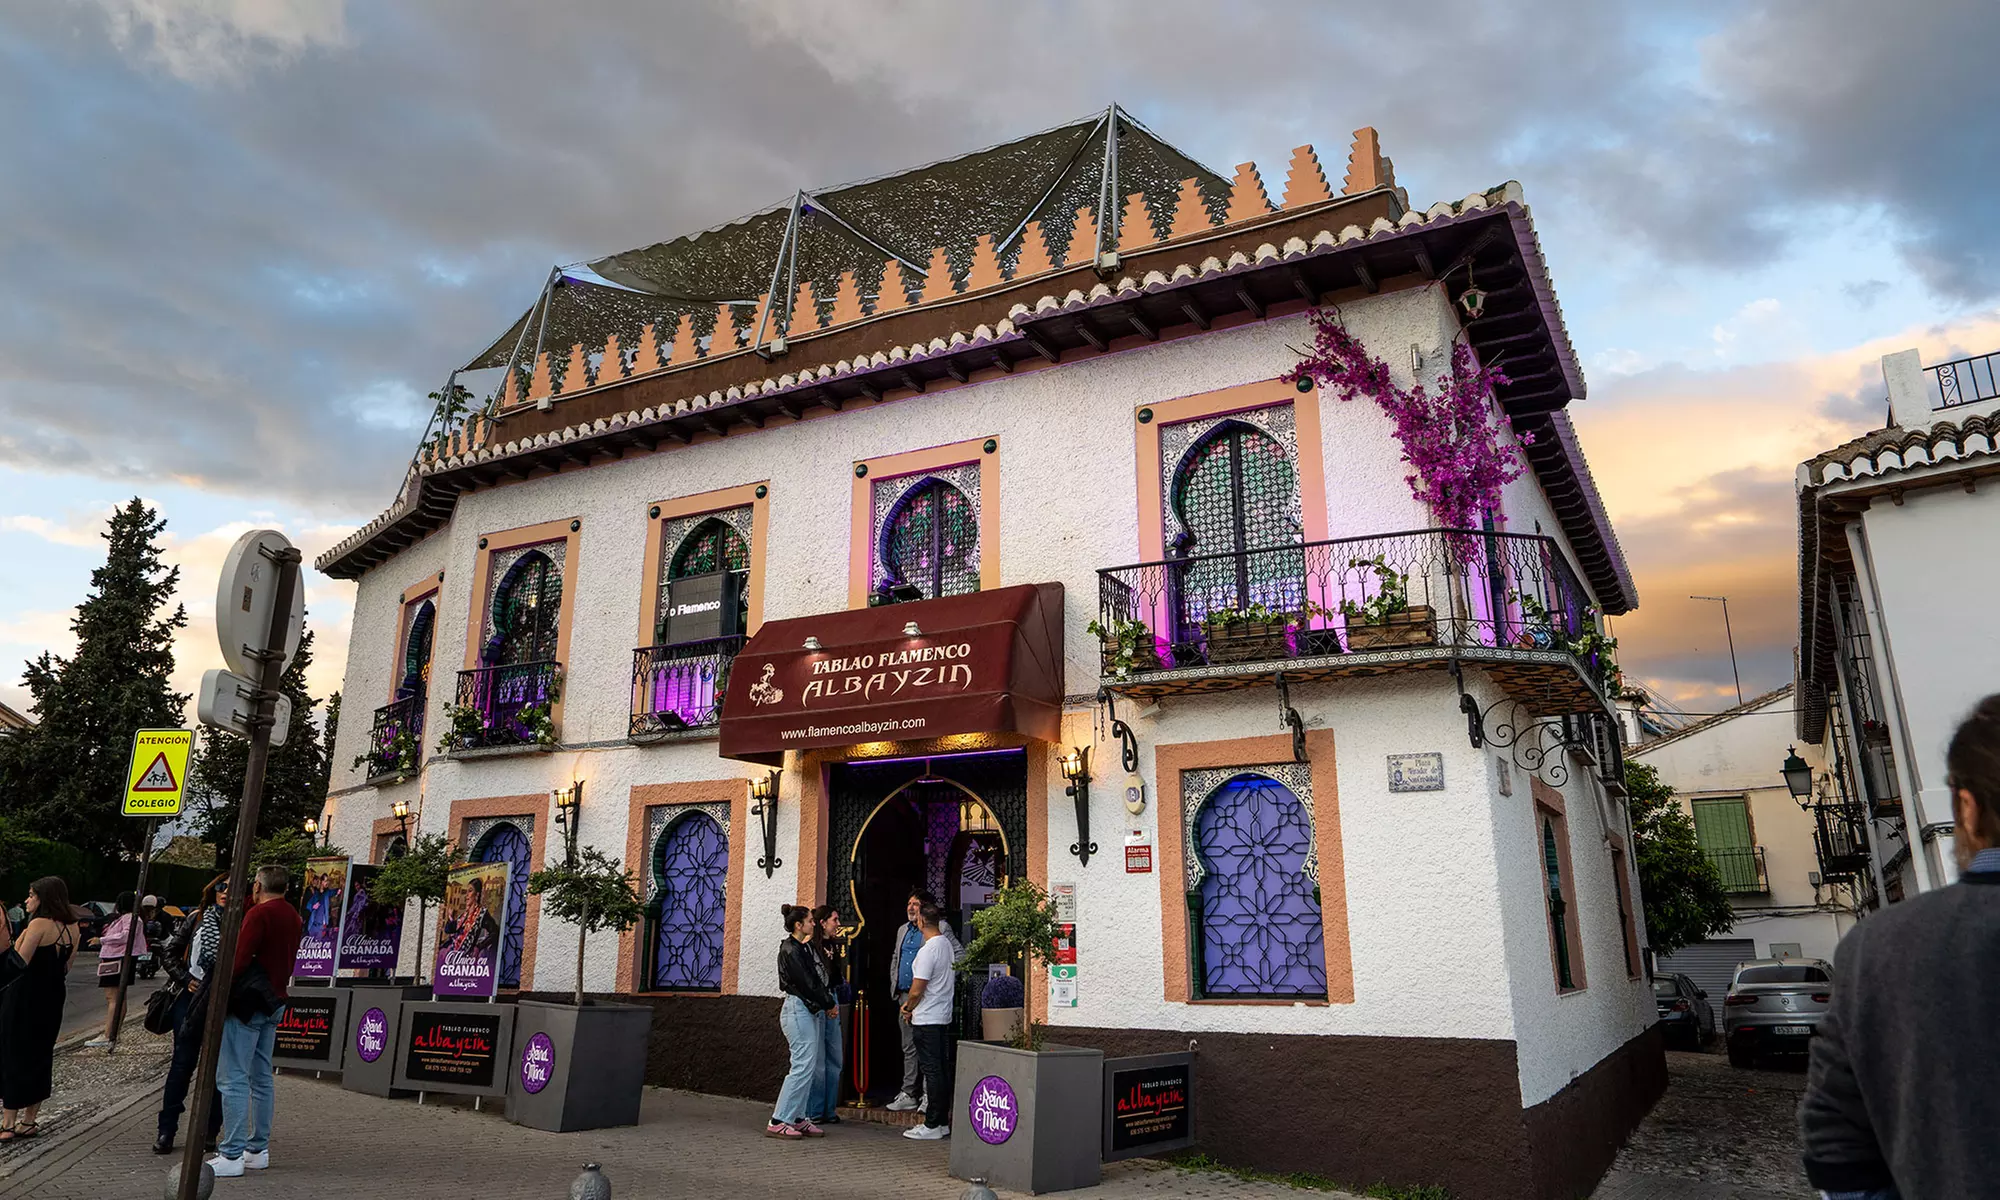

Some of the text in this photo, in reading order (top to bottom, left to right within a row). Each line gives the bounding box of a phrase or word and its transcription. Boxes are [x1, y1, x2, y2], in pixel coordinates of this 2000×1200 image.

[677, 600, 721, 616] Flamenco
[811, 643, 971, 675] TABLAO FLAMENCO
[802, 664, 973, 708] ALBAYZIN
[781, 718, 926, 740] www.flamencoalbayzin.com
[139, 735, 189, 744] ATENCIÓN
[129, 799, 176, 808] COLEGIO
[296, 949, 332, 960] GRANADA
[341, 945, 394, 955] GRANADA
[440, 965, 490, 977] GRANADA
[462, 1026, 490, 1034] FLAMENCO
